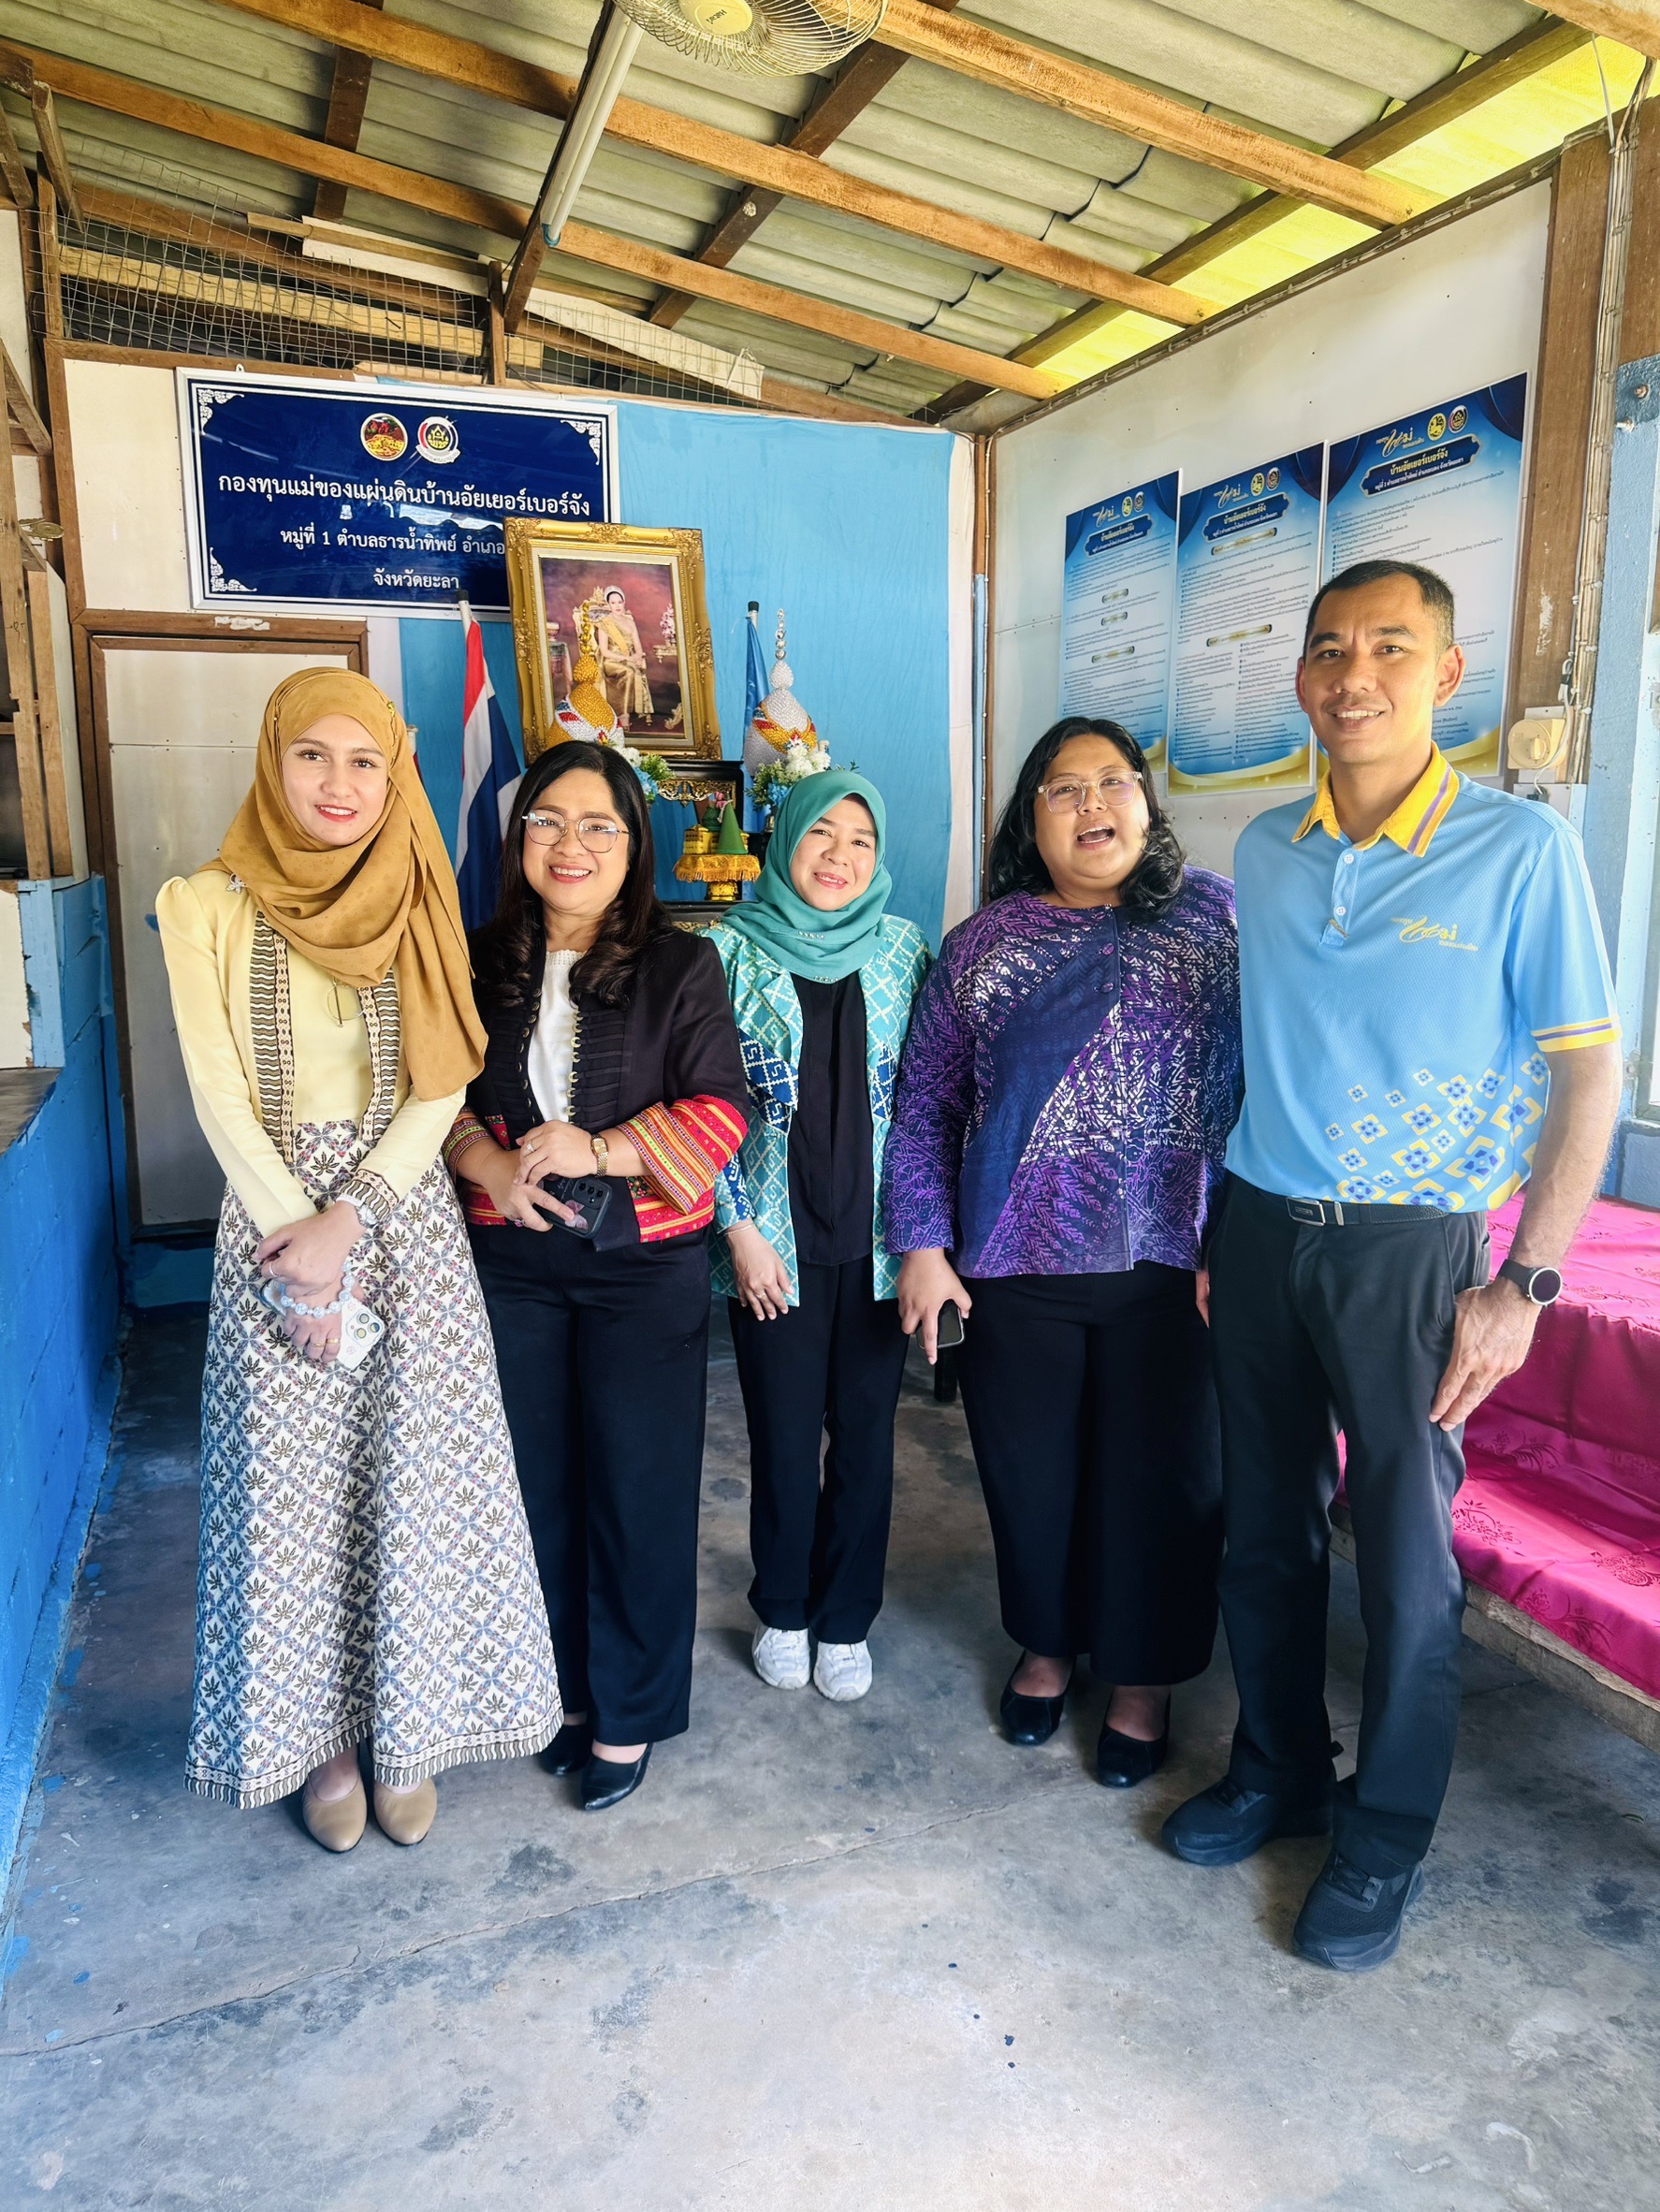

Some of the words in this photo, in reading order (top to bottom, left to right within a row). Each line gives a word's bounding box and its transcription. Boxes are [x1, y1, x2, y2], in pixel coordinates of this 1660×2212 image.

[218, 473, 590, 517] กองทุนแม่ของแผ่นดินบ้านอัยเยอร์เบอร์จัง
[280, 521, 315, 550] หมู่ที่
[322, 531, 330, 546] 1
[337, 527, 457, 553] ตำบลธารน้ำทิพย์
[462, 536, 505, 555] อำเภอ
[373, 567, 460, 589] จังหวัดยะลา
